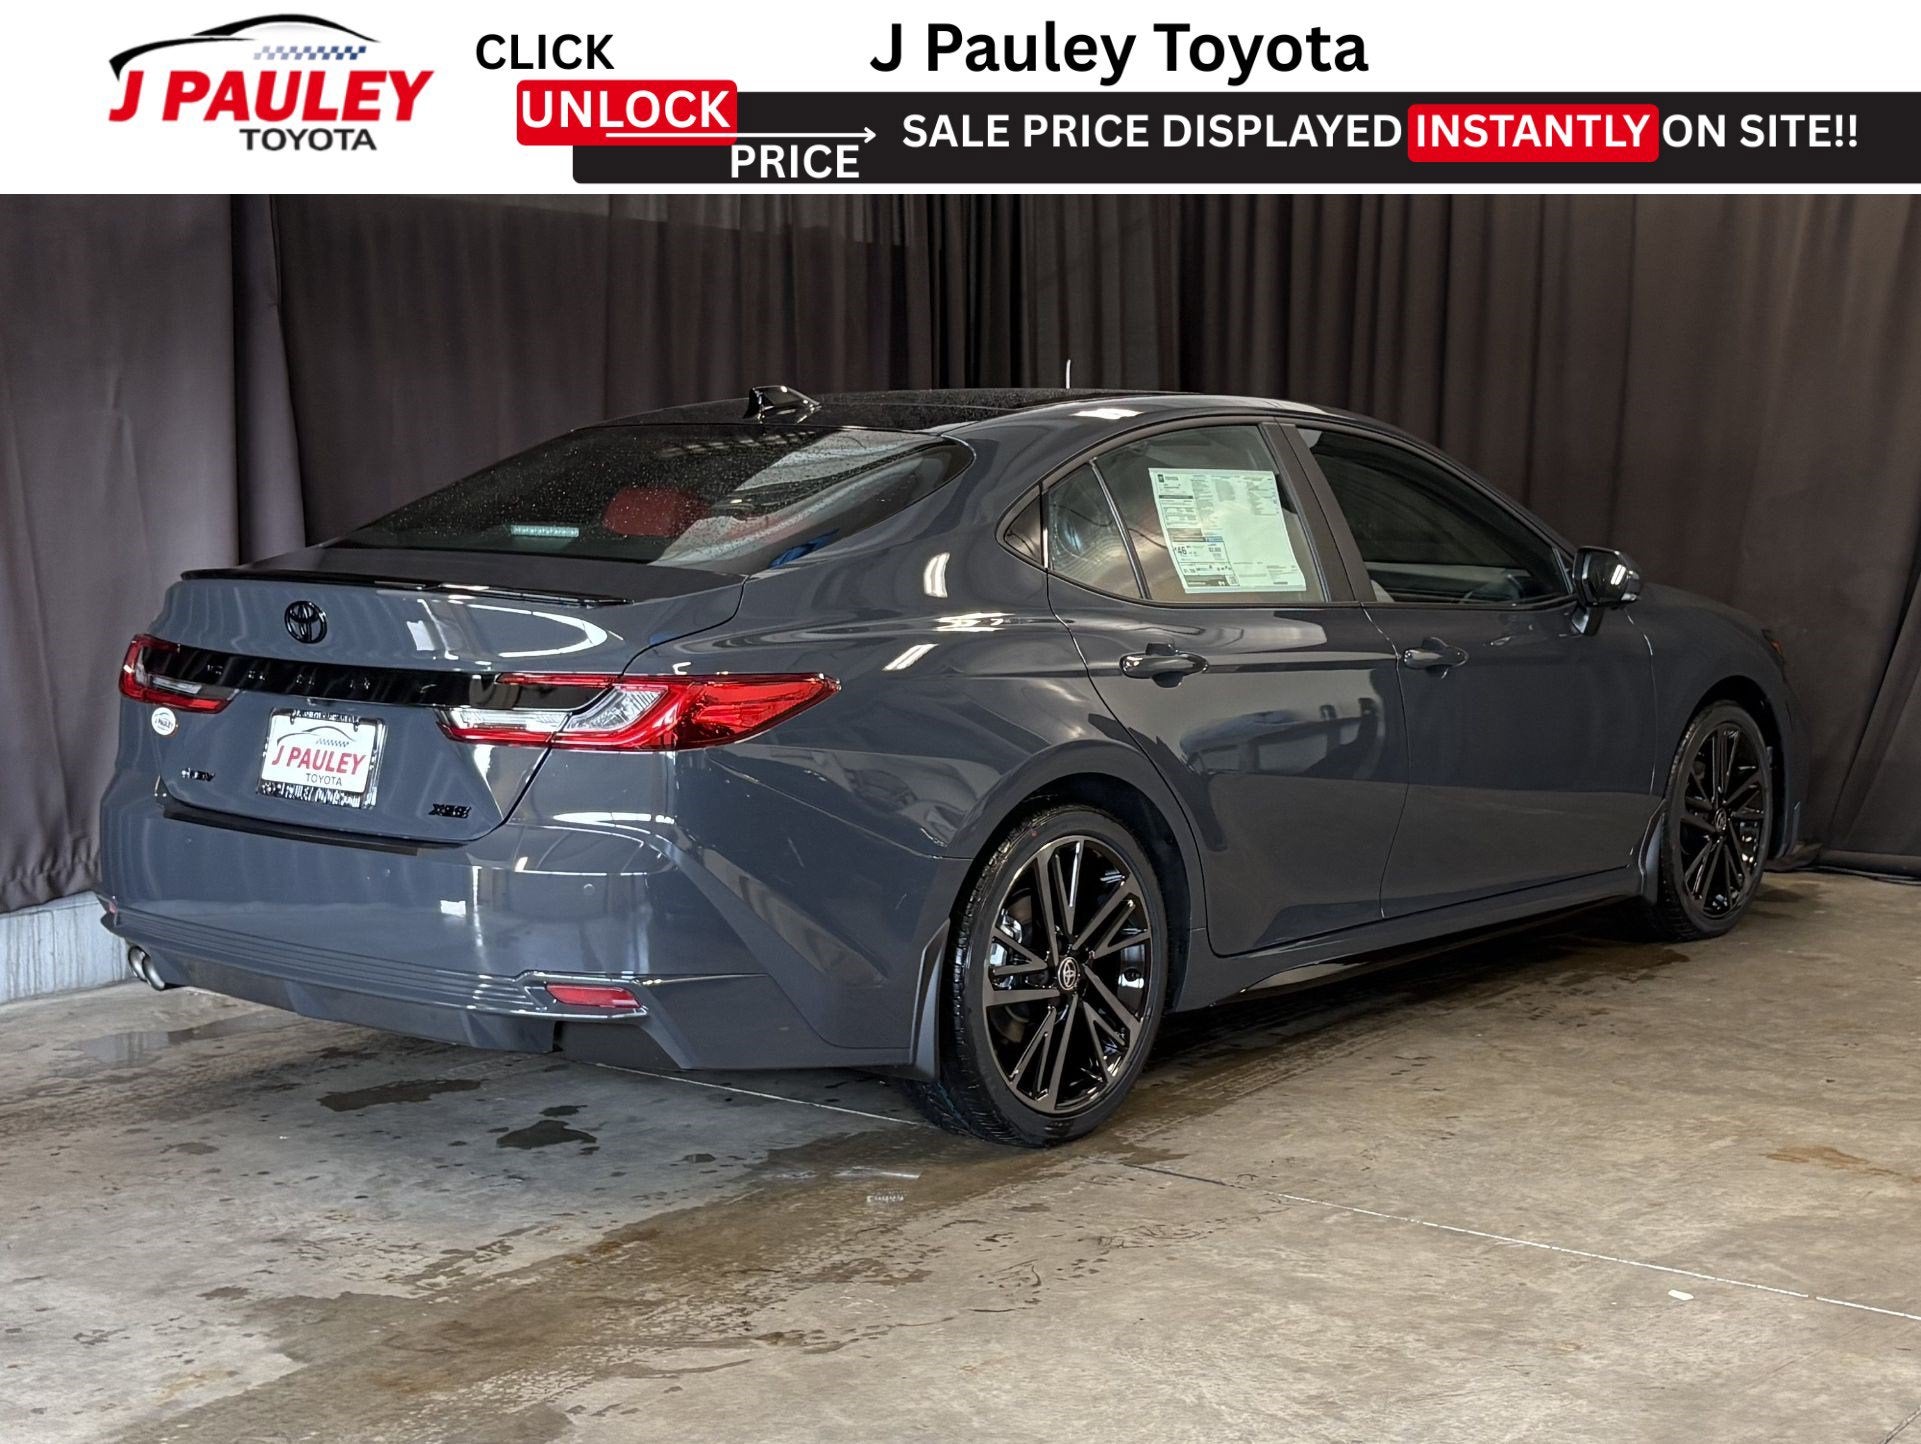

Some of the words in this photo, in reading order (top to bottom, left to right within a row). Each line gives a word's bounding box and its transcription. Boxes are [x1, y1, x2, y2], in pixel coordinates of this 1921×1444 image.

[272, 745, 284, 766] J
[287, 747, 366, 775] PAULEY
[305, 773, 343, 787] TOYOTA
